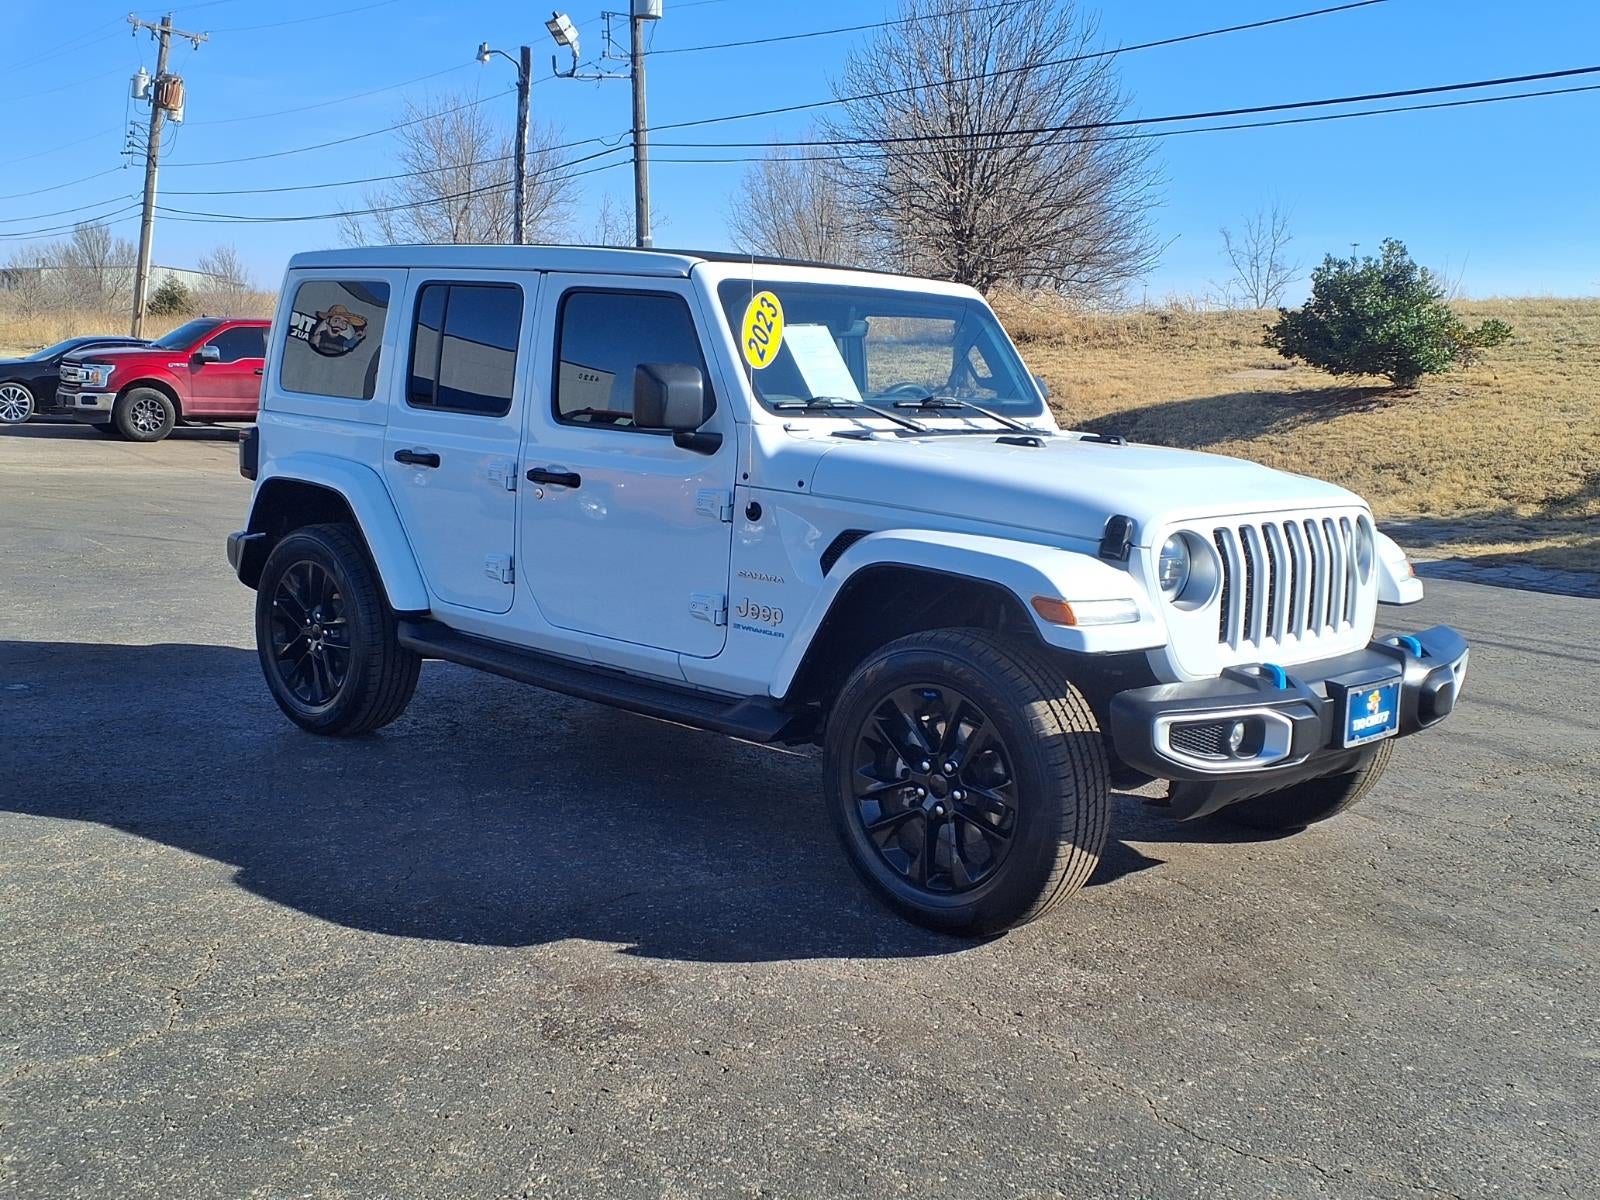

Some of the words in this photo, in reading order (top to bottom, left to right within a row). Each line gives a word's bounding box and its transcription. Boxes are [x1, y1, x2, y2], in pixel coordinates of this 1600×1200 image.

[748, 297, 777, 362] 2023
[737, 569, 785, 584] SAHARA
[736, 597, 784, 627] Jeep
[740, 624, 785, 638] WRANGLER
